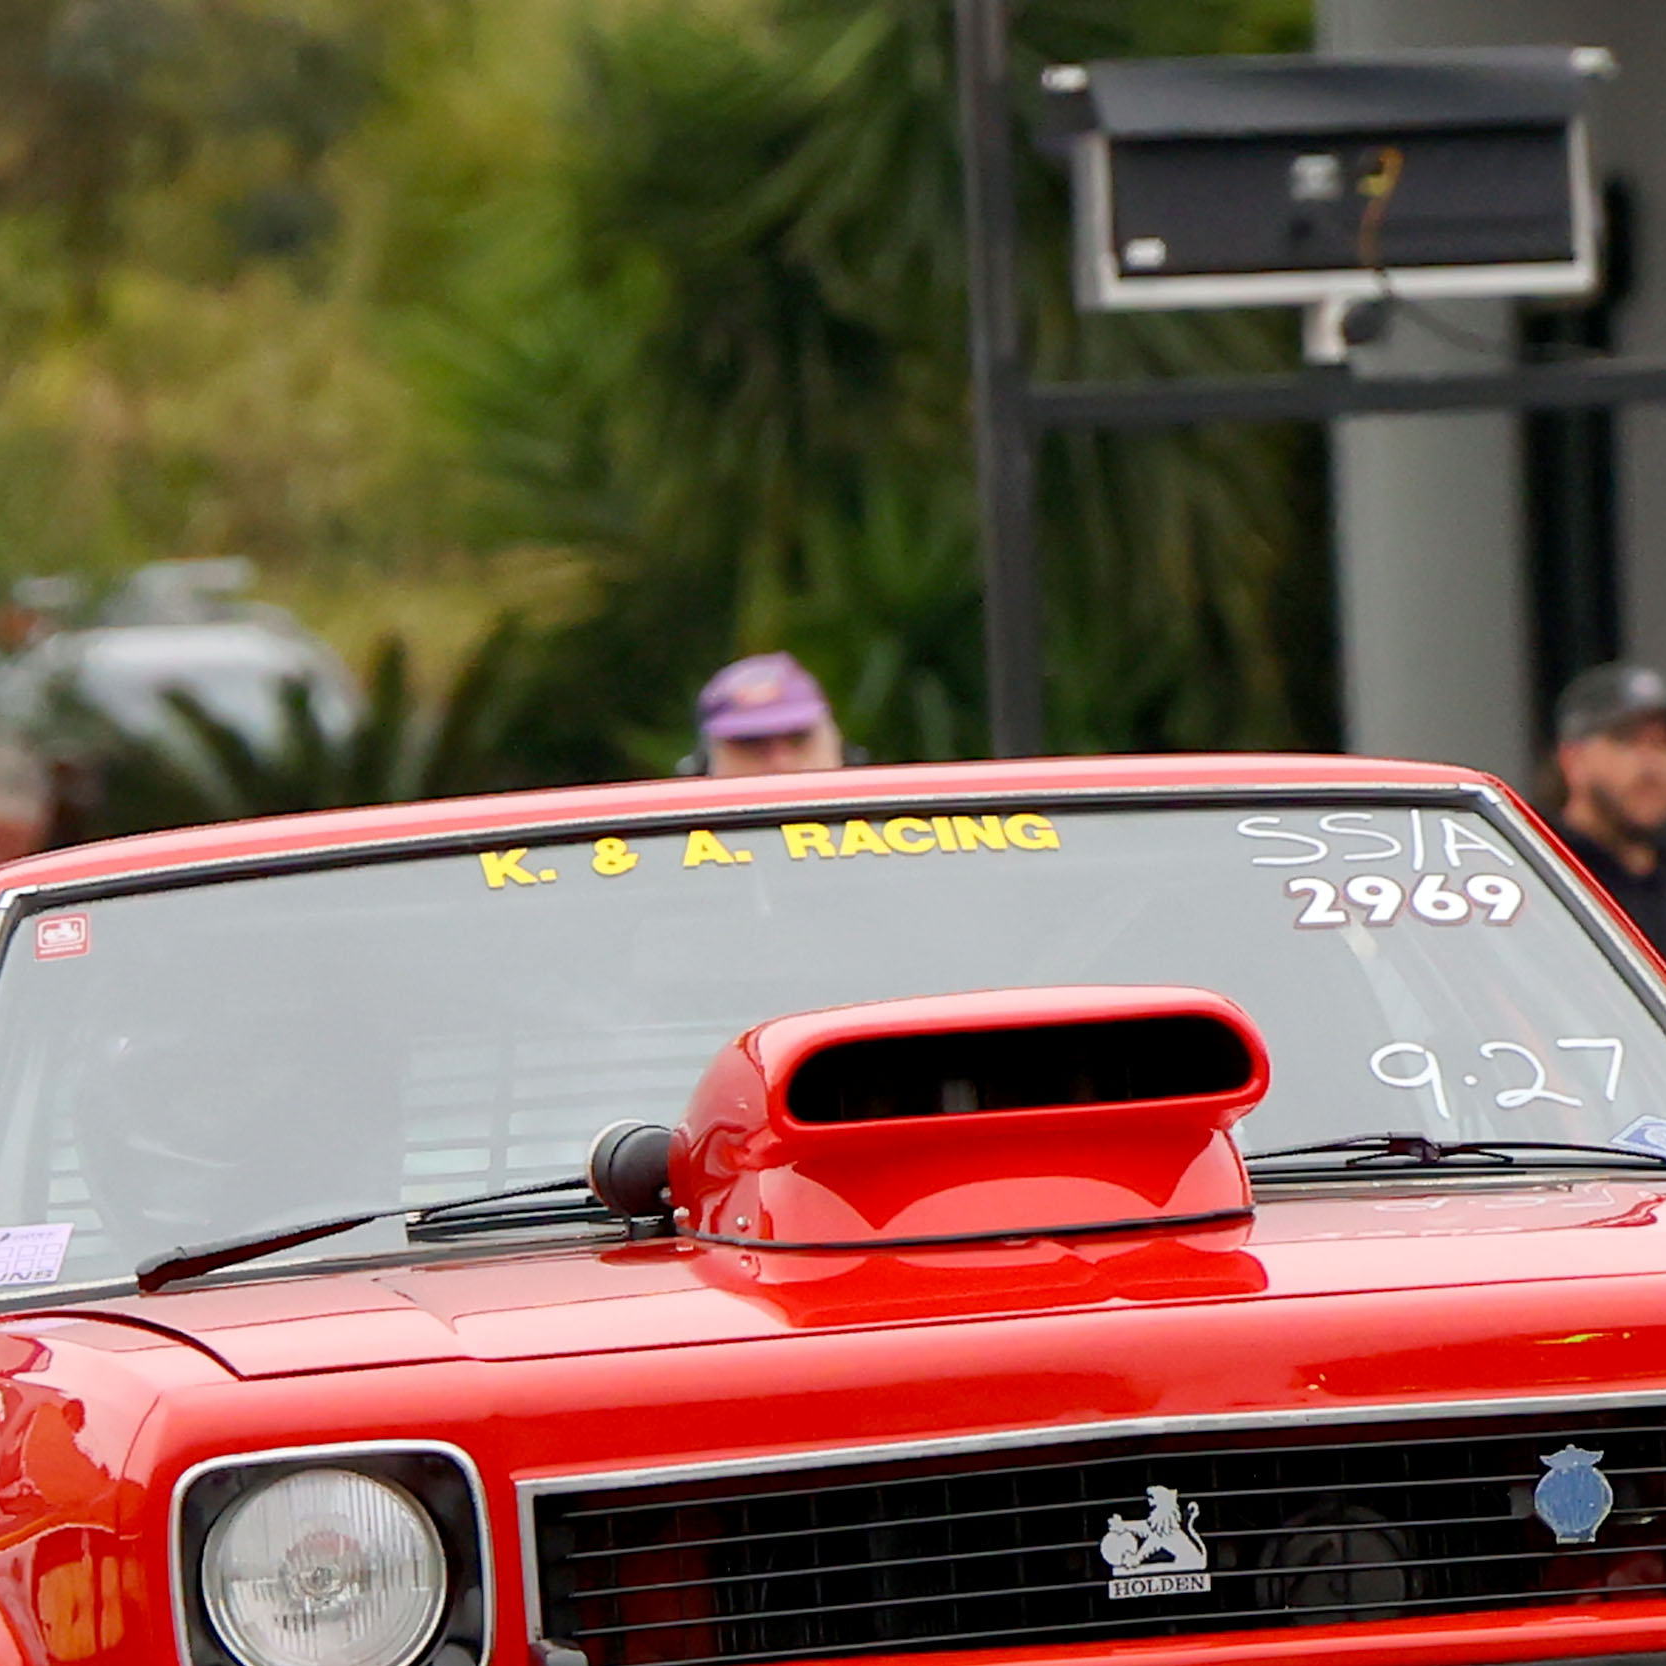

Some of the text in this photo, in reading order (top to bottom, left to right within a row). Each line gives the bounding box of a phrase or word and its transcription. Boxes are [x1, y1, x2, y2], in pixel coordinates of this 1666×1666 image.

[479, 812, 1061, 889] K. & A. RACING
[1284, 874, 1523, 929] 2969
[1369, 1038, 1624, 1120] 9.27
[1113, 1575, 1205, 1597] HOLDEN
